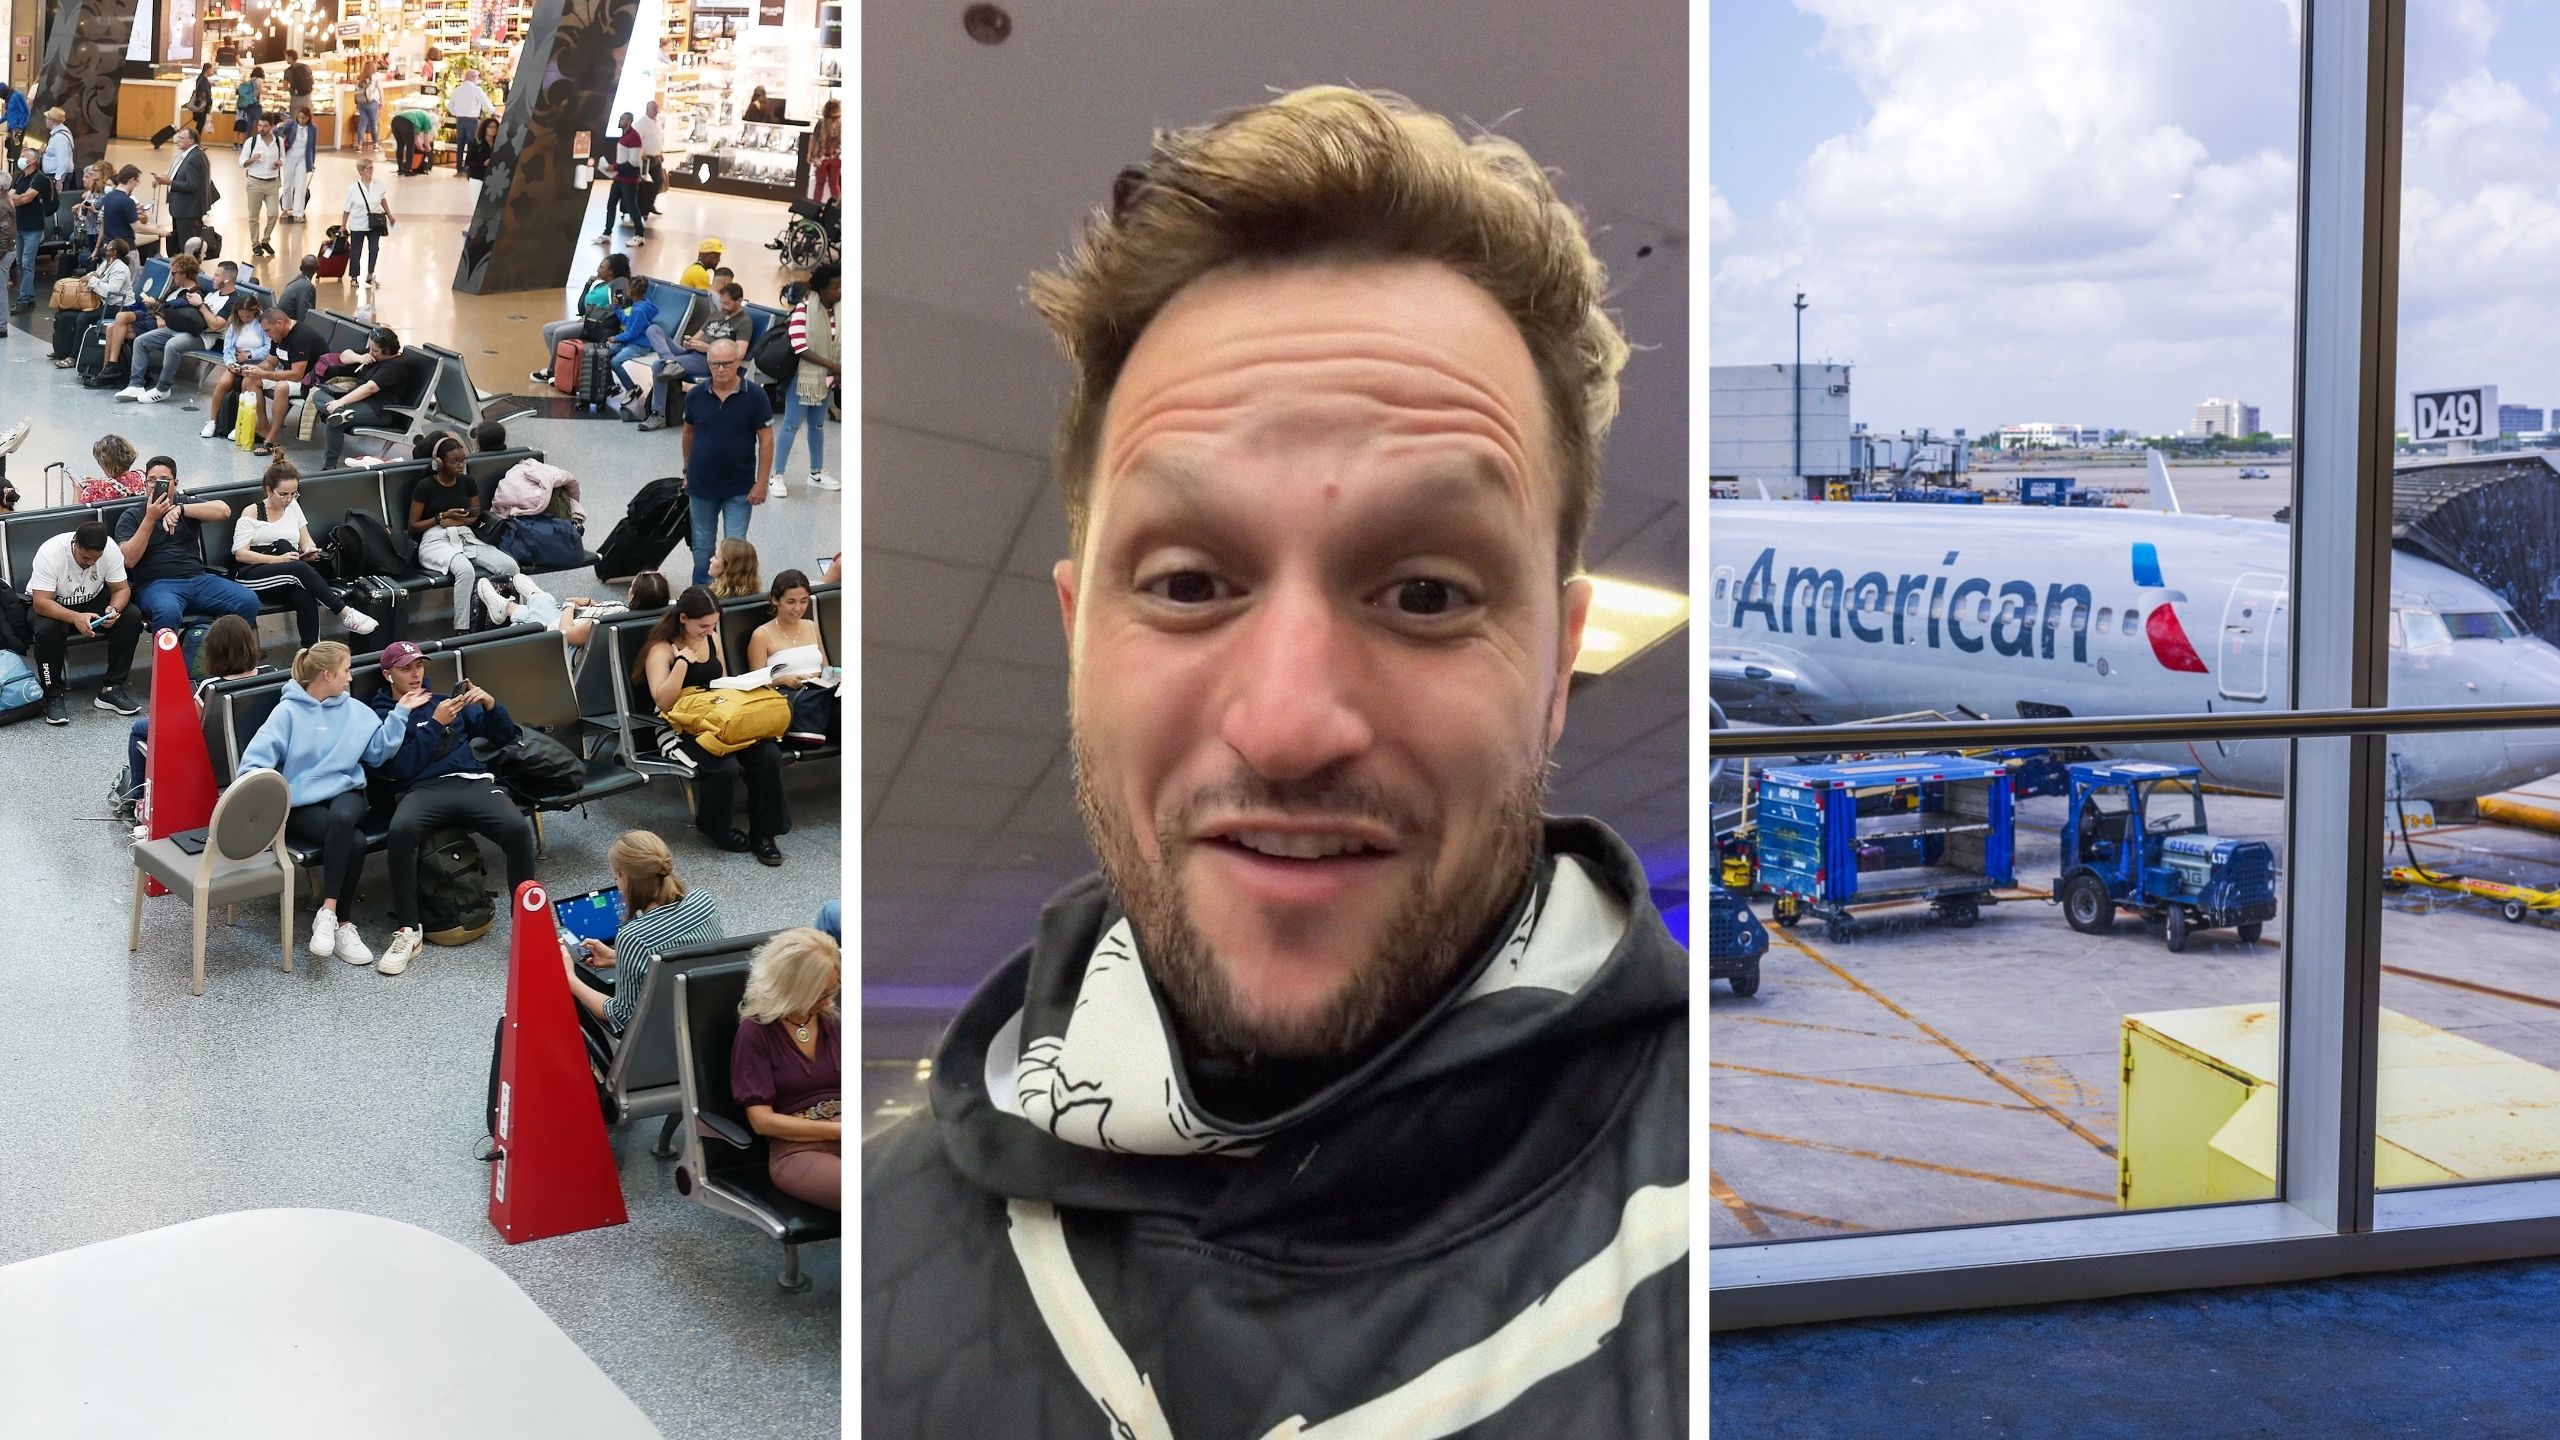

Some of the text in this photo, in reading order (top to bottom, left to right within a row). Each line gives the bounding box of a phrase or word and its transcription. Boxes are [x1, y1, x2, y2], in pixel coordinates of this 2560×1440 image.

[2417, 393, 2479, 439] D49
[1733, 547, 2092, 663] American
[2211, 852, 2229, 865] LTS
